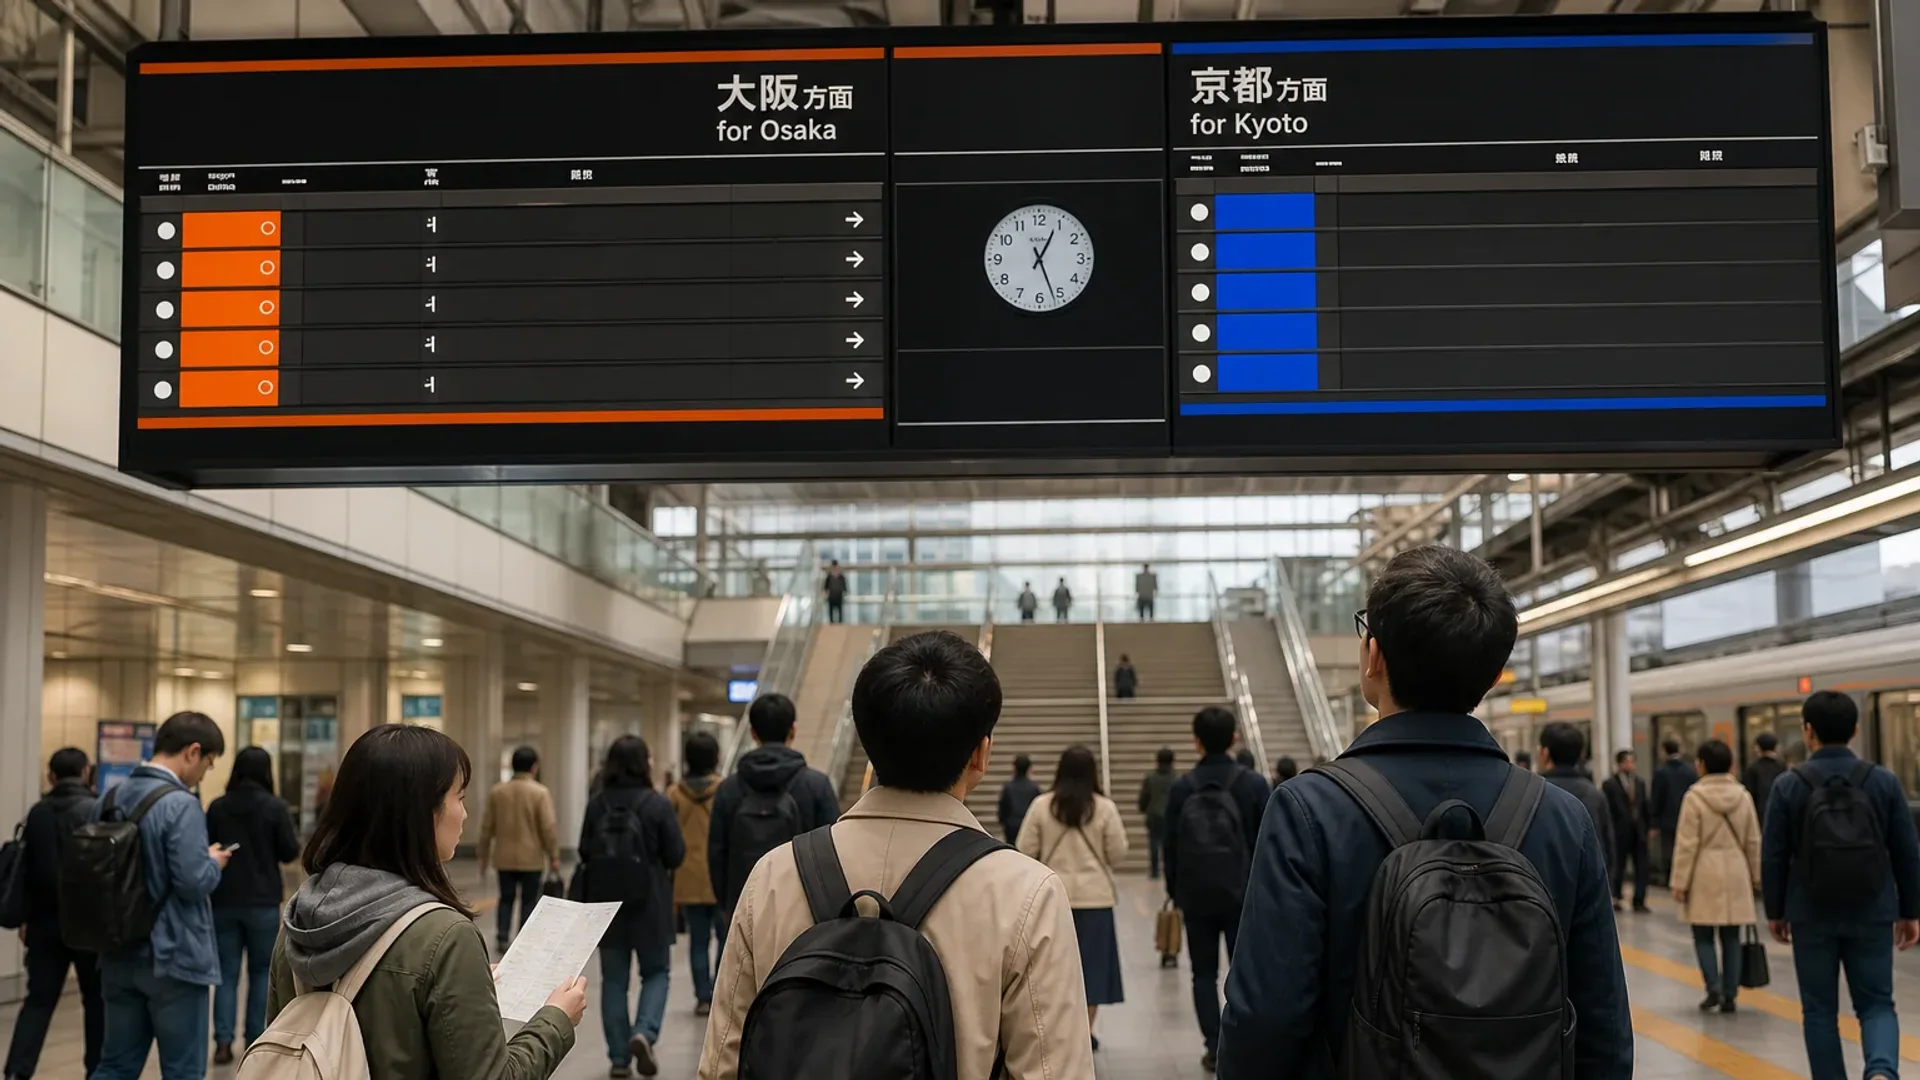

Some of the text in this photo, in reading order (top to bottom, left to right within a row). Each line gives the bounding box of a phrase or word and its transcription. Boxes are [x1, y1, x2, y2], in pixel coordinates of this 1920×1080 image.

[716, 118, 837, 141] for Osaka
[1190, 112, 1308, 140] for Kyoto
[1015, 220, 1025, 231] 11
[1032, 214, 1046, 226] 12
[1000, 234, 1013, 246] 10
[1070, 233, 1079, 245] 2
[993, 253, 1003, 265] 9
[1076, 253, 1085, 265] 3
[1000, 273, 1009, 285] 8
[1069, 273, 1079, 284] 4
[1016, 288, 1024, 299] 7
[1035, 292, 1044, 304] 6
[1056, 287, 1065, 298] 5
